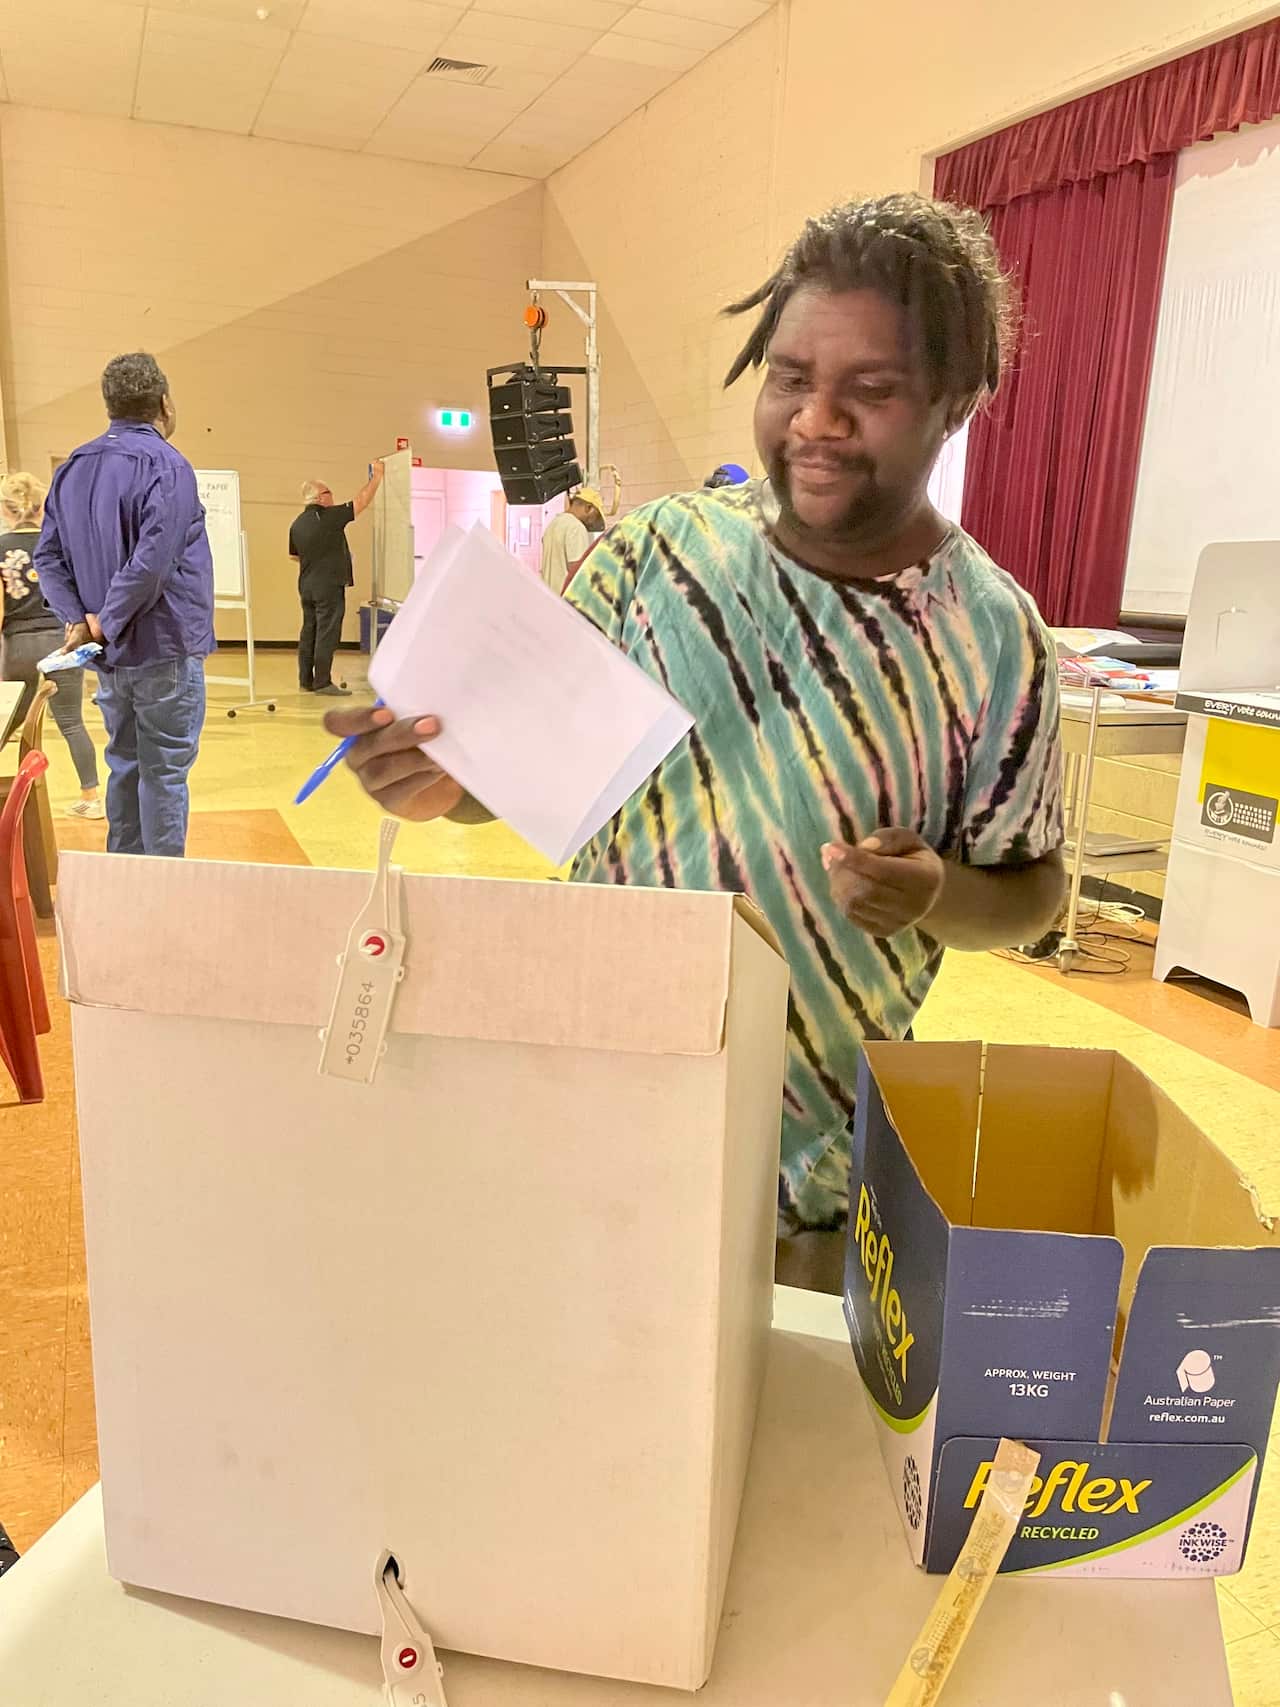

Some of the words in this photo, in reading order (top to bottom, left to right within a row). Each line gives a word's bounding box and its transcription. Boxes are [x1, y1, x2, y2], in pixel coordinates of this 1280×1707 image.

[855, 1182, 915, 1384] Reflex
[984, 1368, 1030, 1379] APPROX.
[1032, 1370, 1077, 1381] WEIGHT
[1008, 1383, 1049, 1398] 13KG
[1143, 1395, 1201, 1407] Australian
[1202, 1396, 1237, 1409] Paper
[1149, 1411, 1226, 1424] reflex.com.au
[1020, 1526, 1099, 1540] RECYCLED
